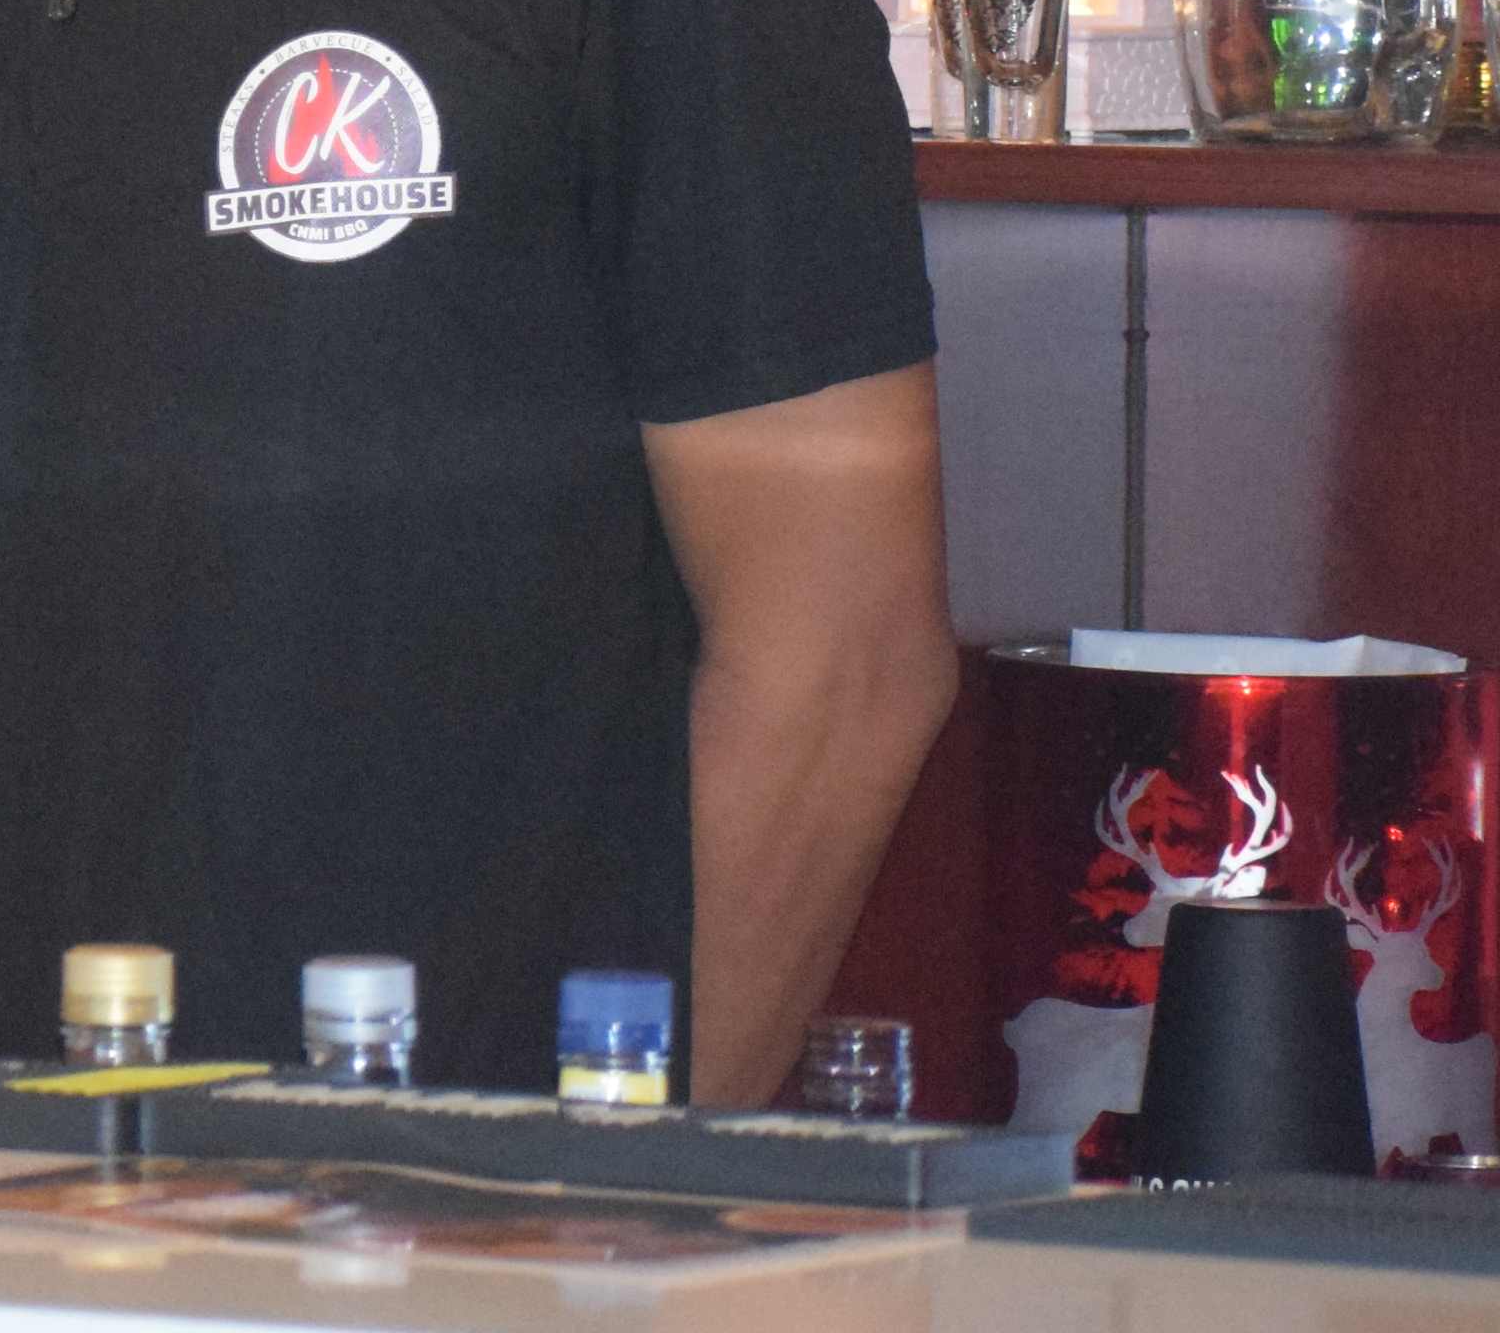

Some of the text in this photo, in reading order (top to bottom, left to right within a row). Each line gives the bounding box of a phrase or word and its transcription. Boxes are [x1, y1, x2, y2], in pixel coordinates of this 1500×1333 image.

[274, 34, 373, 64] BARVECUE
[397, 66, 434, 127] SALAD
[275, 71, 392, 175] CK
[215, 181, 448, 226] SMOKEHOUSE
[289, 219, 369, 241] CNMI BBQ
